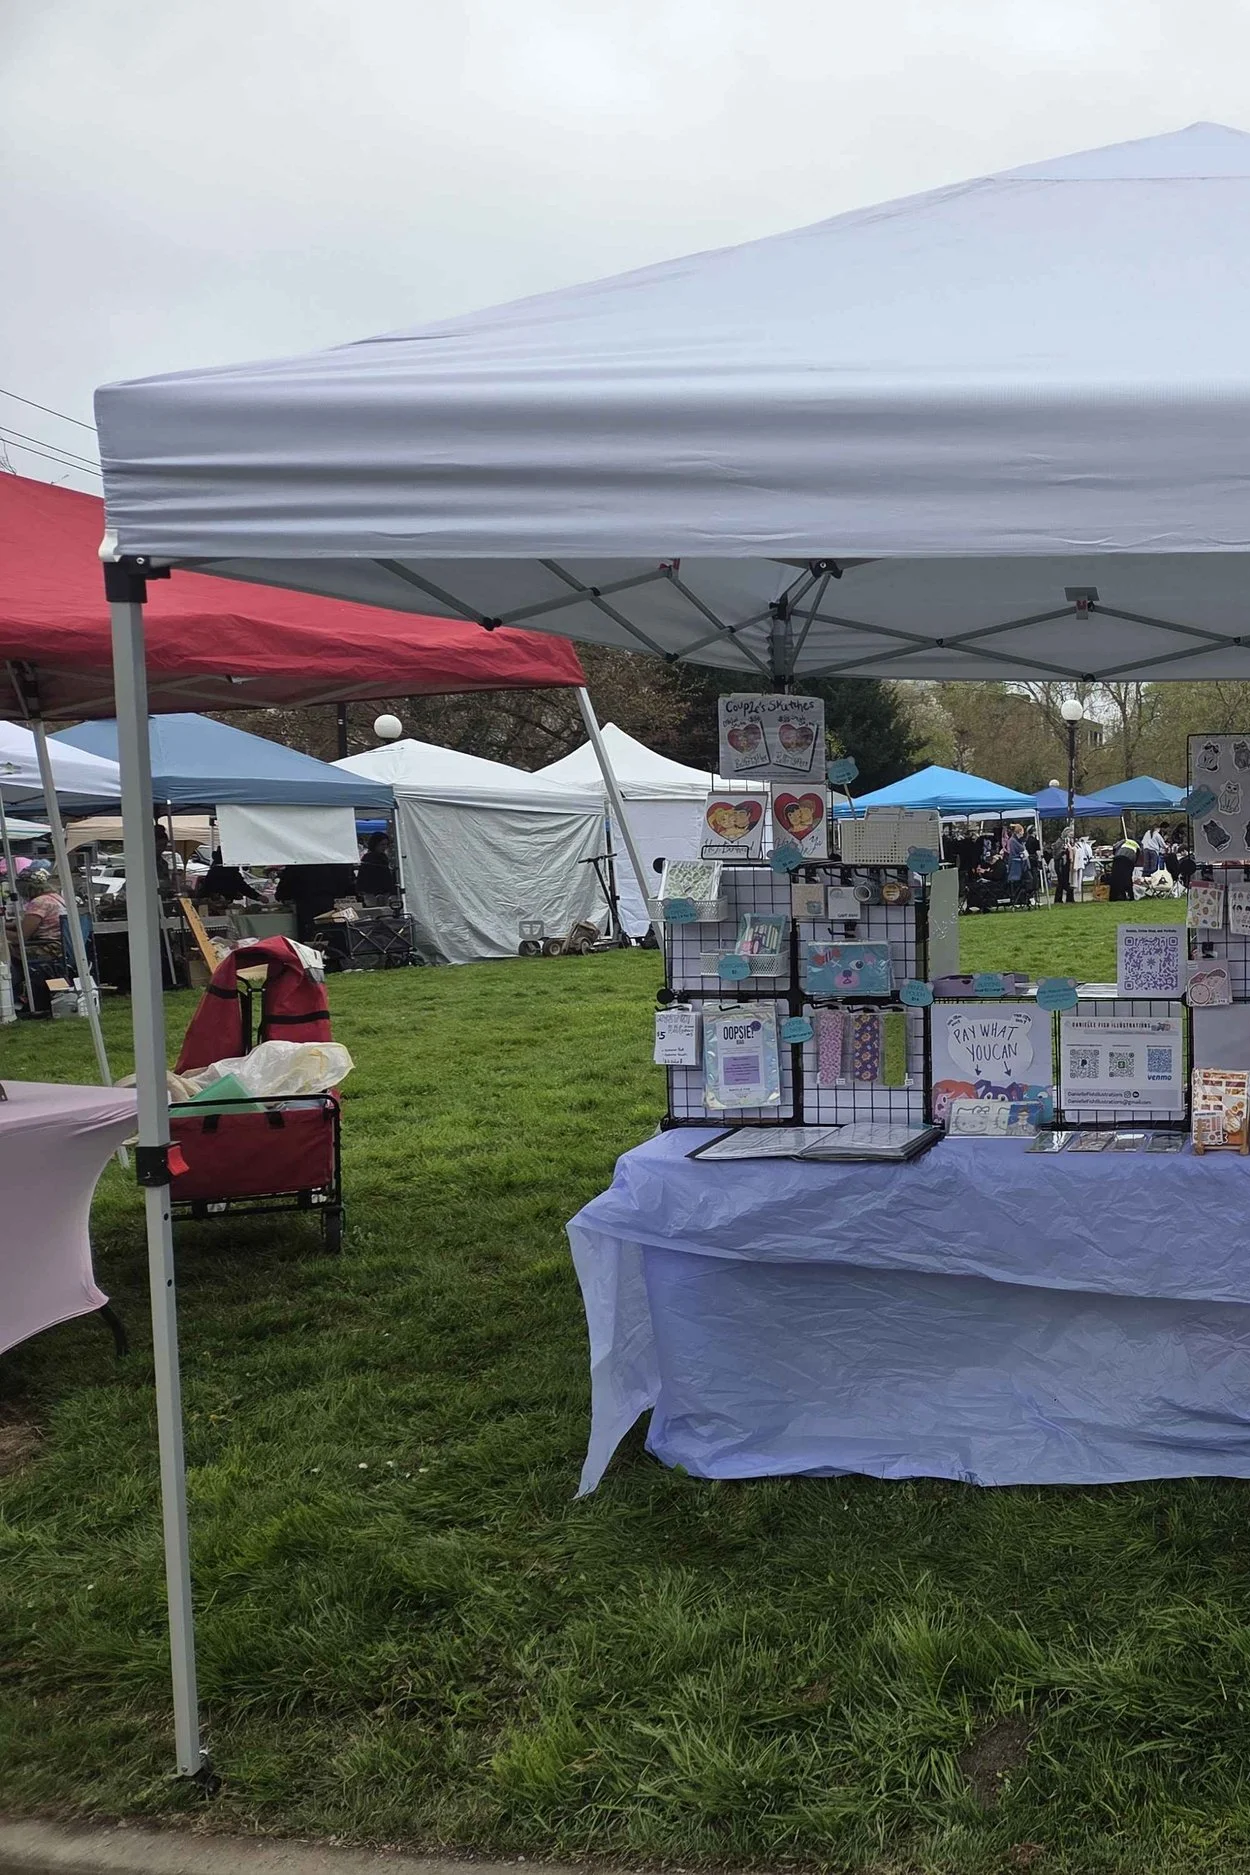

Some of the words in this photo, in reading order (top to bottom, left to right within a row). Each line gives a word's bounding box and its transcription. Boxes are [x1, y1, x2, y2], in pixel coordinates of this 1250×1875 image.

[723, 1024, 755, 1041] OOPSIE!
[953, 1024, 976, 1044] PAY
[980, 1022, 1019, 1041] WHAT
